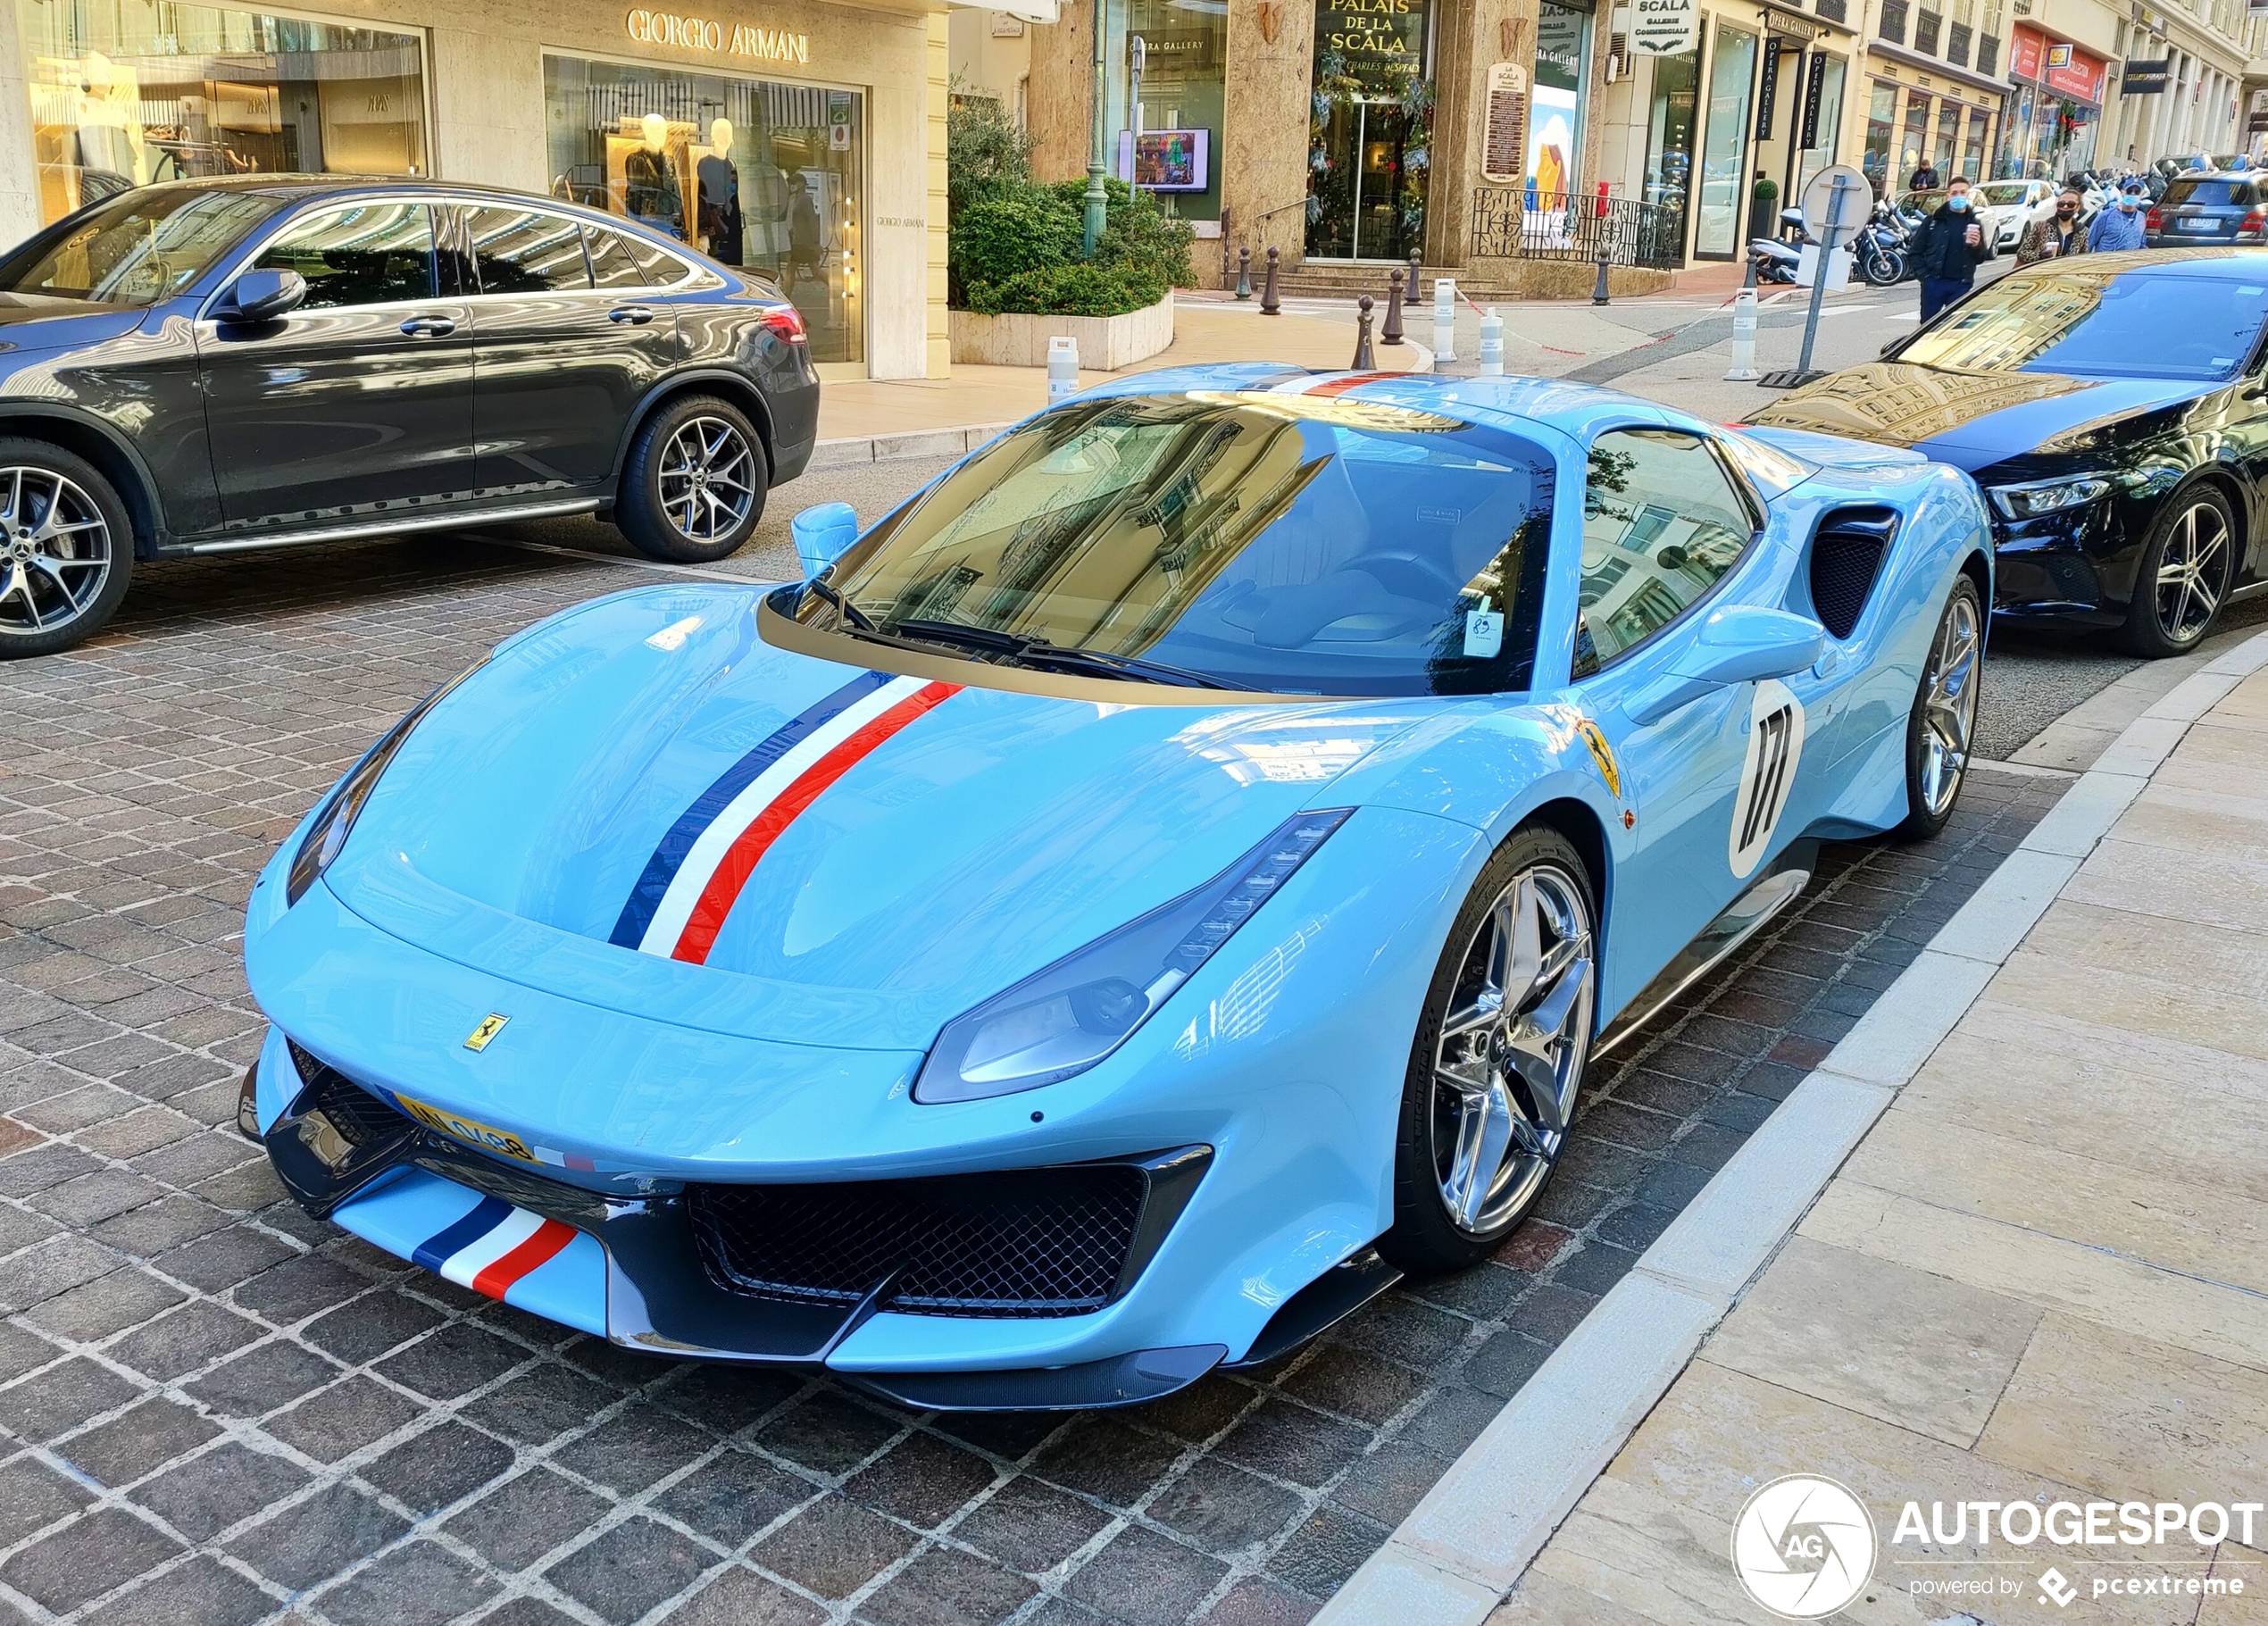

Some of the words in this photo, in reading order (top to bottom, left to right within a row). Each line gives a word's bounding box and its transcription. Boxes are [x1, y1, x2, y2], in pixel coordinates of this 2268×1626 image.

[1638, 0, 1690, 12] SCALA
[1345, 16, 1366, 29] DE
[1372, 18, 1393, 30] LA
[1769, 13, 1789, 29] OPERA
[1790, 20, 1815, 38] GALLERY
[627, 9, 721, 51] GIORGIO
[728, 23, 810, 63] ARMANI
[1330, 33, 1407, 53] SCALA
[1163, 41, 1204, 50] GALLERY
[1347, 61, 1381, 71] CHARLES
[1549, 51, 1579, 66] GALLERY
[1766, 42, 1777, 81] OPERA
[1498, 72, 1520, 80] SCALA
[1812, 56, 1822, 93] OPERA
[1761, 84, 1772, 136] GALLERY
[1805, 96, 1816, 146] GALLERY
[877, 216, 902, 227] GIORGIO
[902, 218, 924, 228] ARMANI
[1473, 618, 1489, 634] 89
